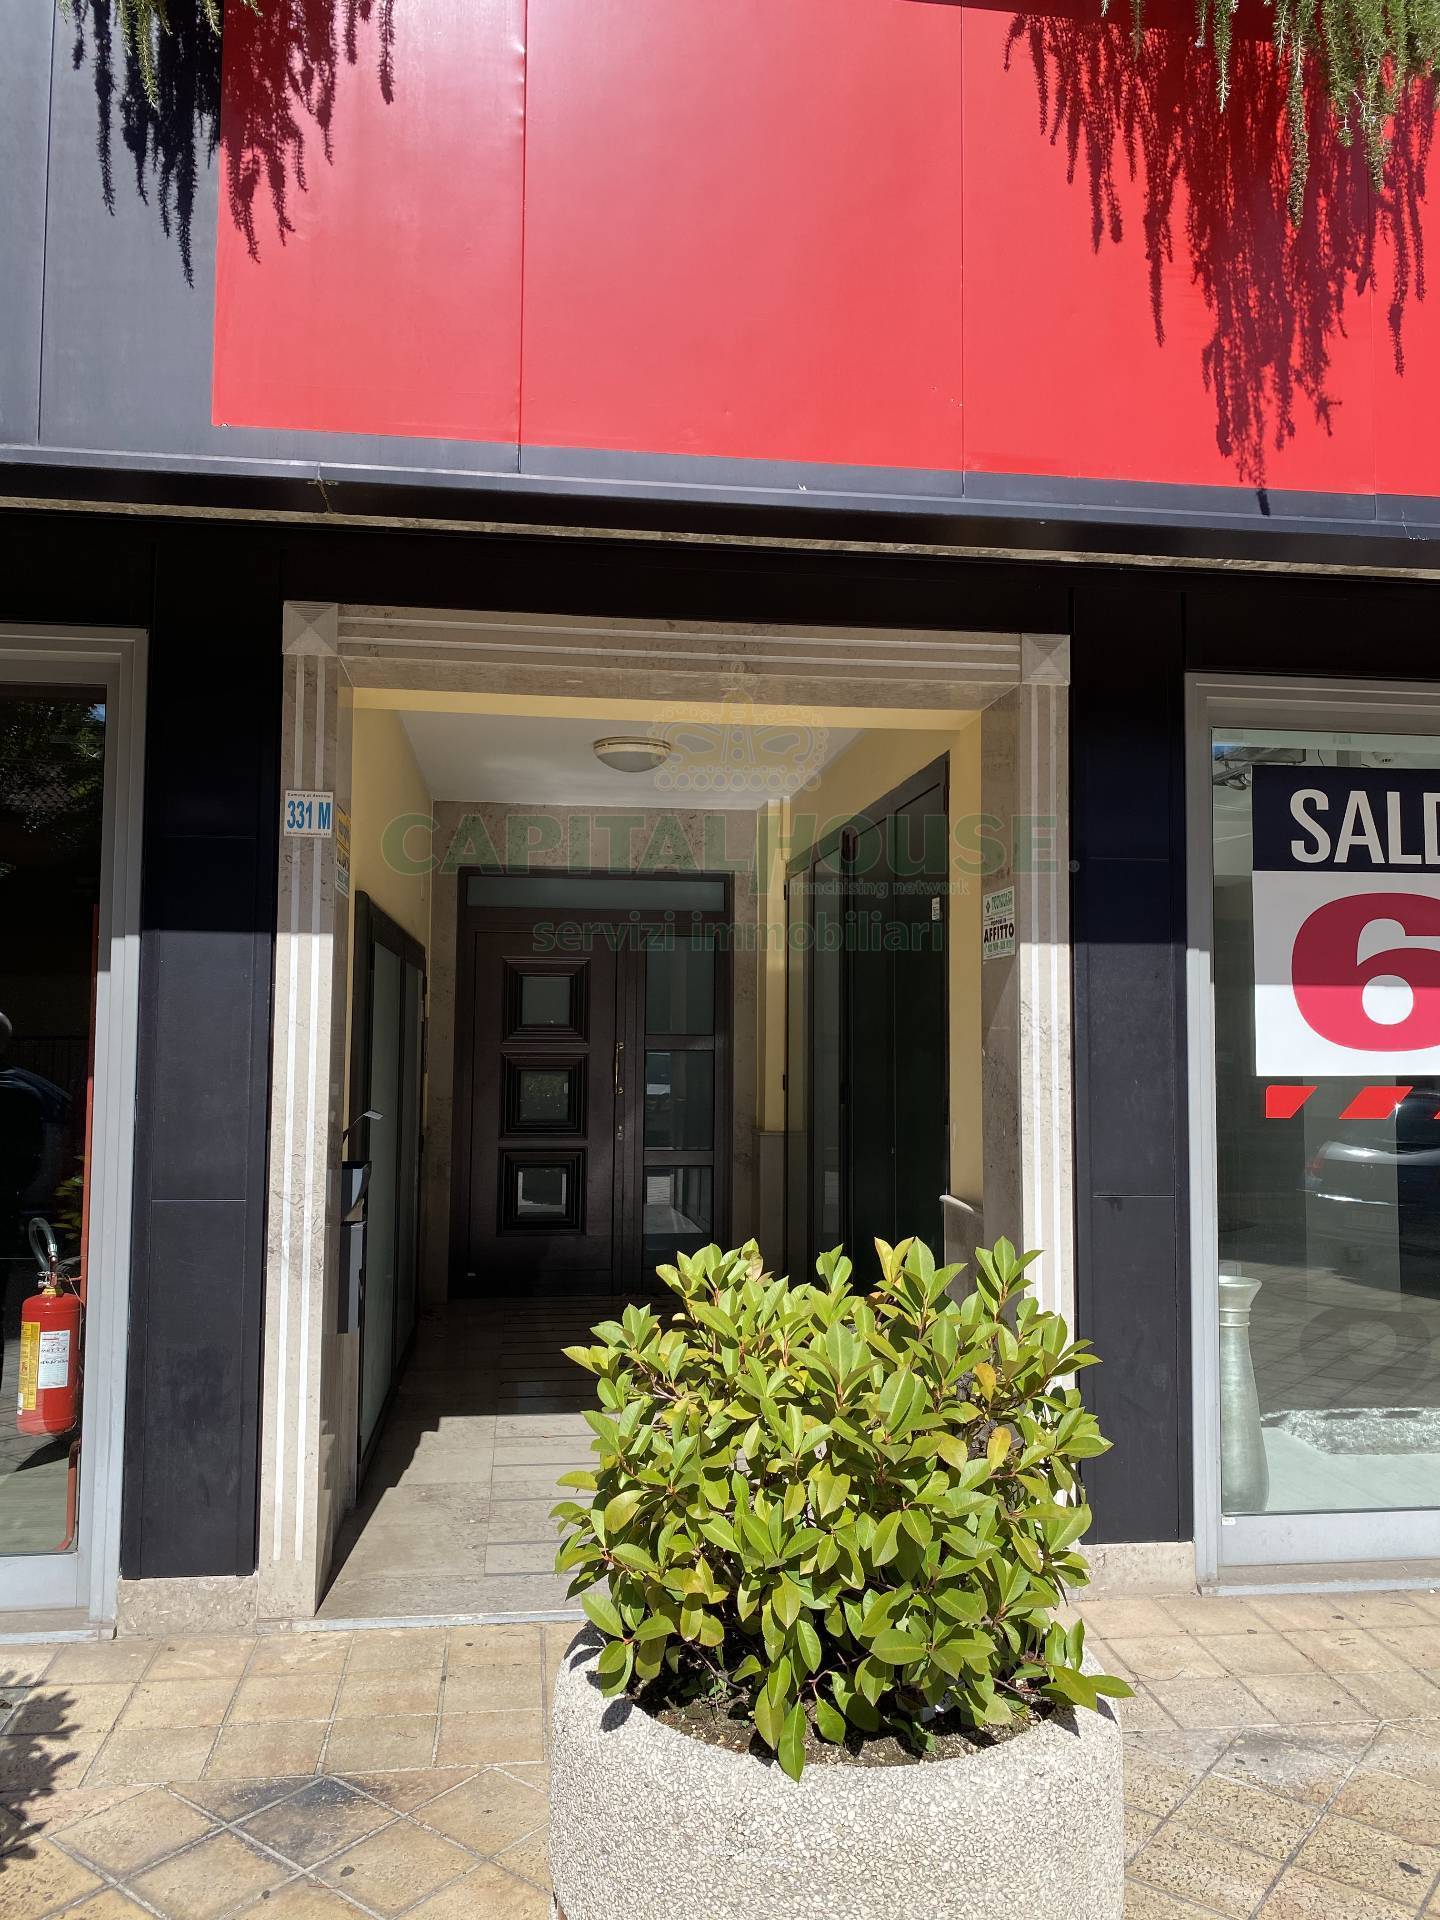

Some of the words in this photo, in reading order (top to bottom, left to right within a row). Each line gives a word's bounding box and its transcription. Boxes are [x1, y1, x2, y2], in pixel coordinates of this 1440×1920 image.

[287, 800, 312, 829] 331
[318, 802, 331, 829] M
[984, 922, 1014, 944] AFFITTO
[1292, 893, 1440, 1052] 6
